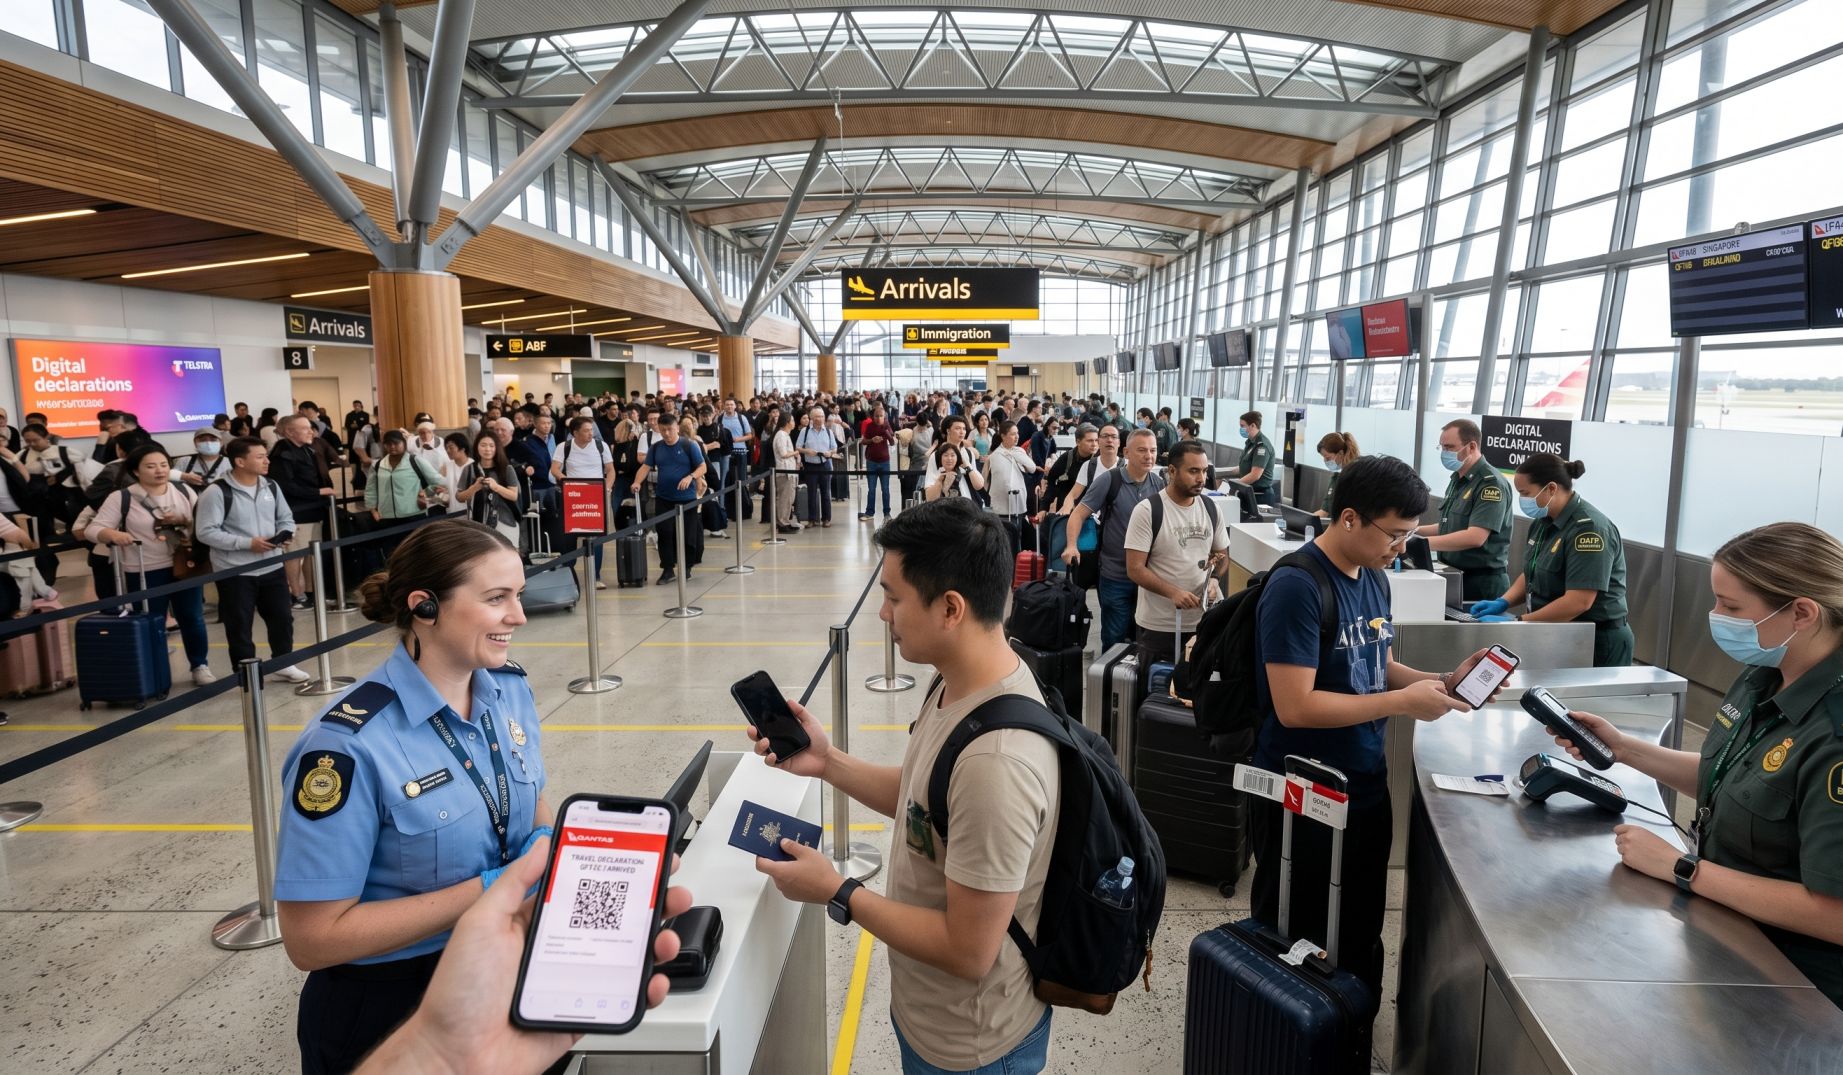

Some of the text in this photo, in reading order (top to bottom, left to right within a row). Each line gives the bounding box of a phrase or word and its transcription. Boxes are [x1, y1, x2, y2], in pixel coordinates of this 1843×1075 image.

[1703, 240, 1741, 253] SINGAPORE
[880, 277, 971, 300] Arrivals
[309, 317, 366, 338] Arrivals
[921, 328, 991, 342] Immigration
[525, 341, 547, 351] ABF
[184, 360, 214, 370] TELSTRA
[291, 351, 302, 366] 8
[31, 357, 86, 377] Digital
[34, 377, 133, 392] declarations
[1505, 423, 1543, 438] DIGITAL
[1487, 436, 1562, 455] DECLARATIONS
[577, 834, 614, 843] QANTAS
[572, 854, 596, 863] TRAVEL
